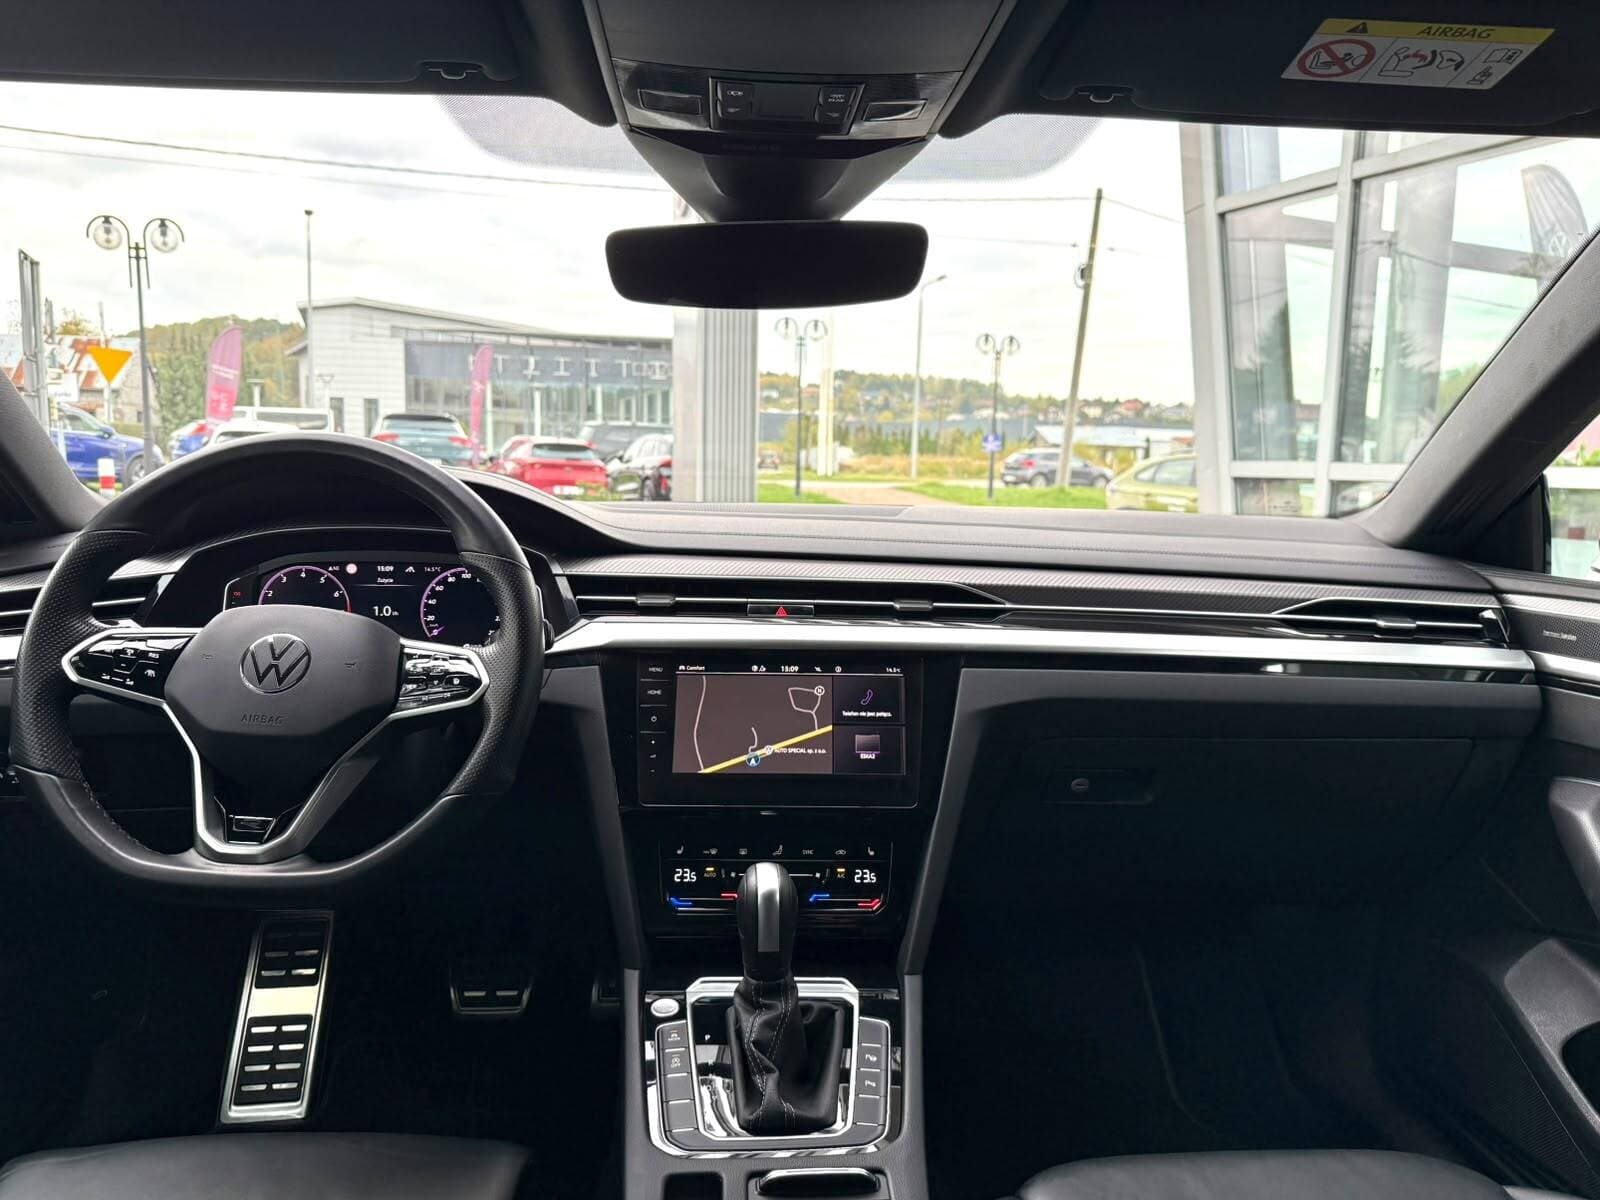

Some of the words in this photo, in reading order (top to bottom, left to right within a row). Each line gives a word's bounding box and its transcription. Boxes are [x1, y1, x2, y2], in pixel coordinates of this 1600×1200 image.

[1416, 26, 1494, 39] AIRBAG
[320, 576, 326, 584] 5
[373, 605, 392, 616] 1.0
[241, 713, 283, 725] AIRBAG
[674, 868, 697, 882] 23.5
[854, 869, 877, 883] 23.5
